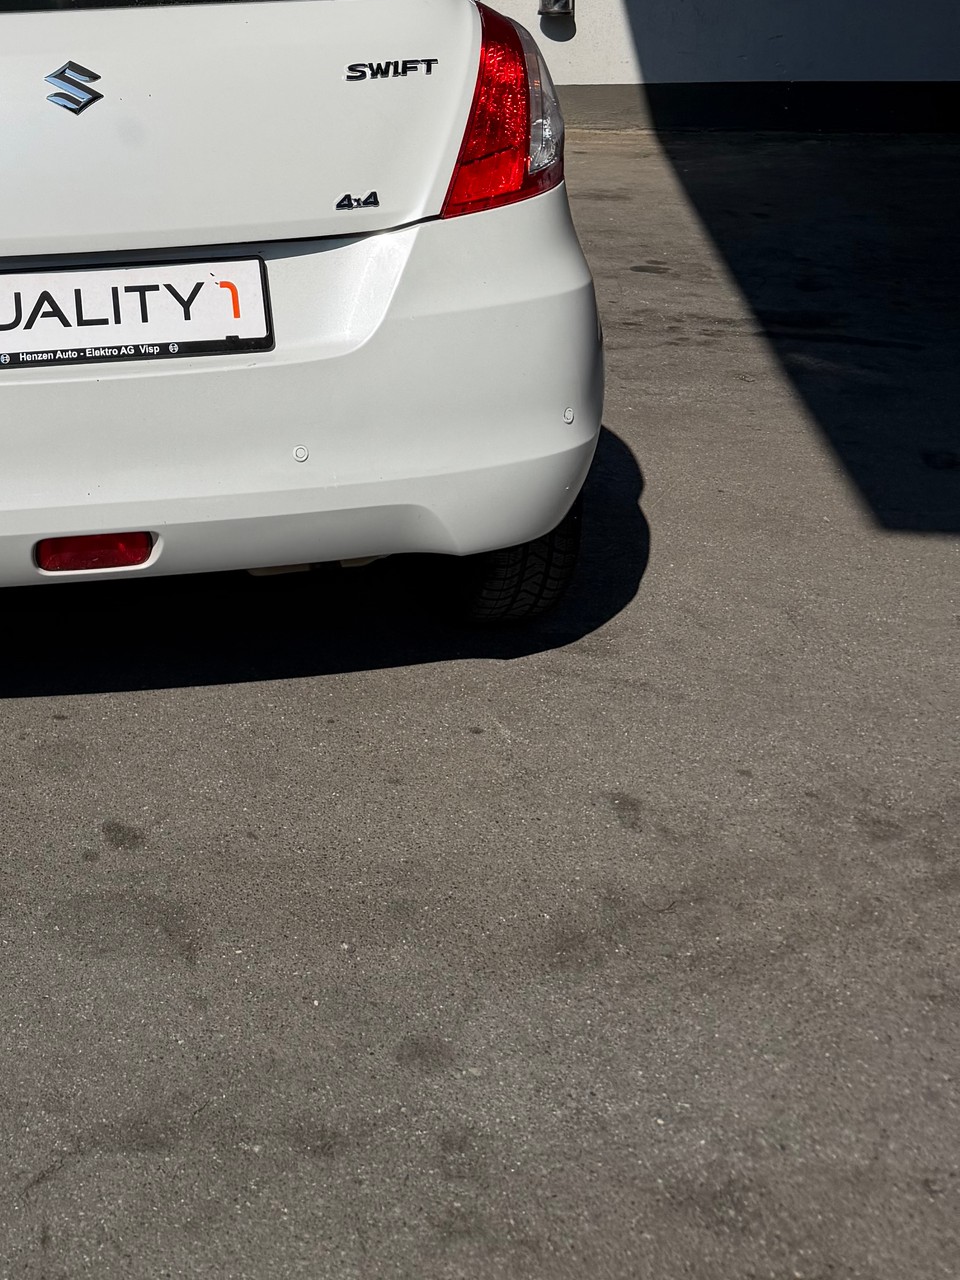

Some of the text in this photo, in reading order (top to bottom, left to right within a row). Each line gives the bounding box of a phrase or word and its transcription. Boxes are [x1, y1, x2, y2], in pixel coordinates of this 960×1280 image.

[344, 58, 439, 81] SWIFT
[19, 351, 54, 362] Henzen
[55, 349, 78, 360] Auto
[85, 347, 118, 358] Elektro
[120, 345, 135, 355] AG
[139, 343, 160, 356] Visp
